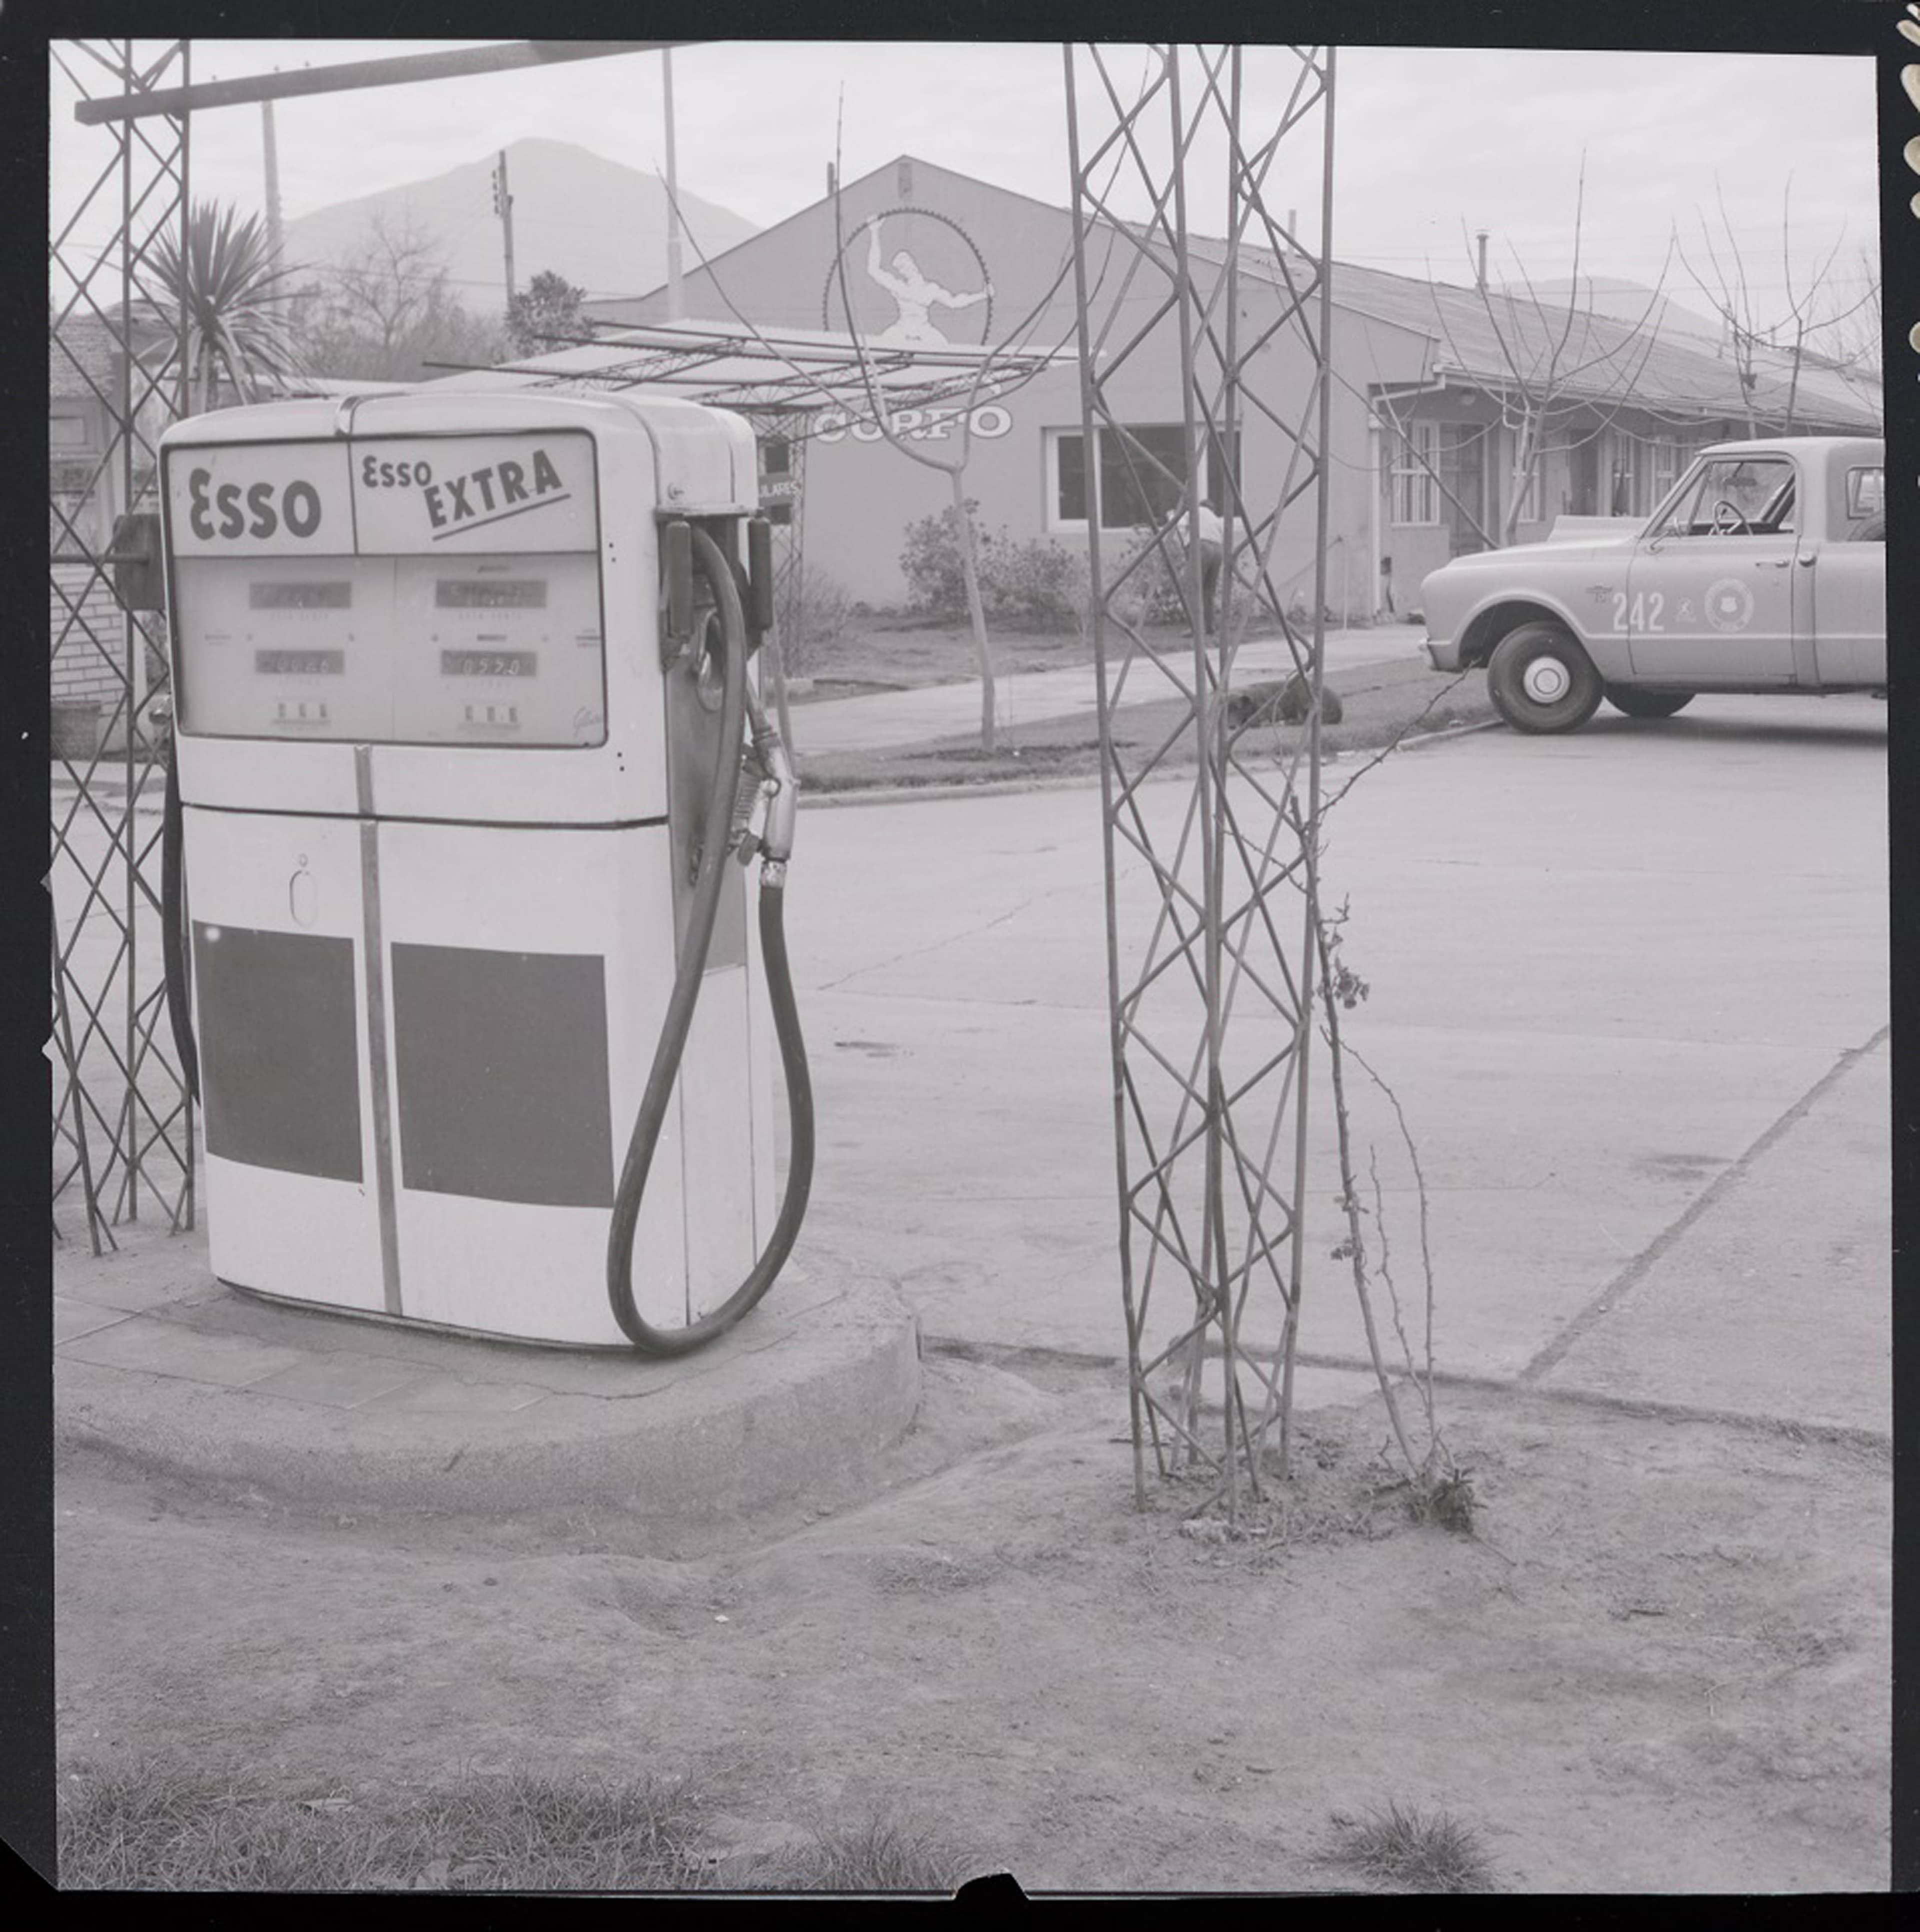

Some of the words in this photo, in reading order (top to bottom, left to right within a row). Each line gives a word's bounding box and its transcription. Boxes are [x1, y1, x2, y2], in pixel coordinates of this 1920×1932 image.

[812, 405, 1012, 443] CORFO
[423, 450, 563, 528] EXTRA
[1613, 592, 1664, 630] 242
